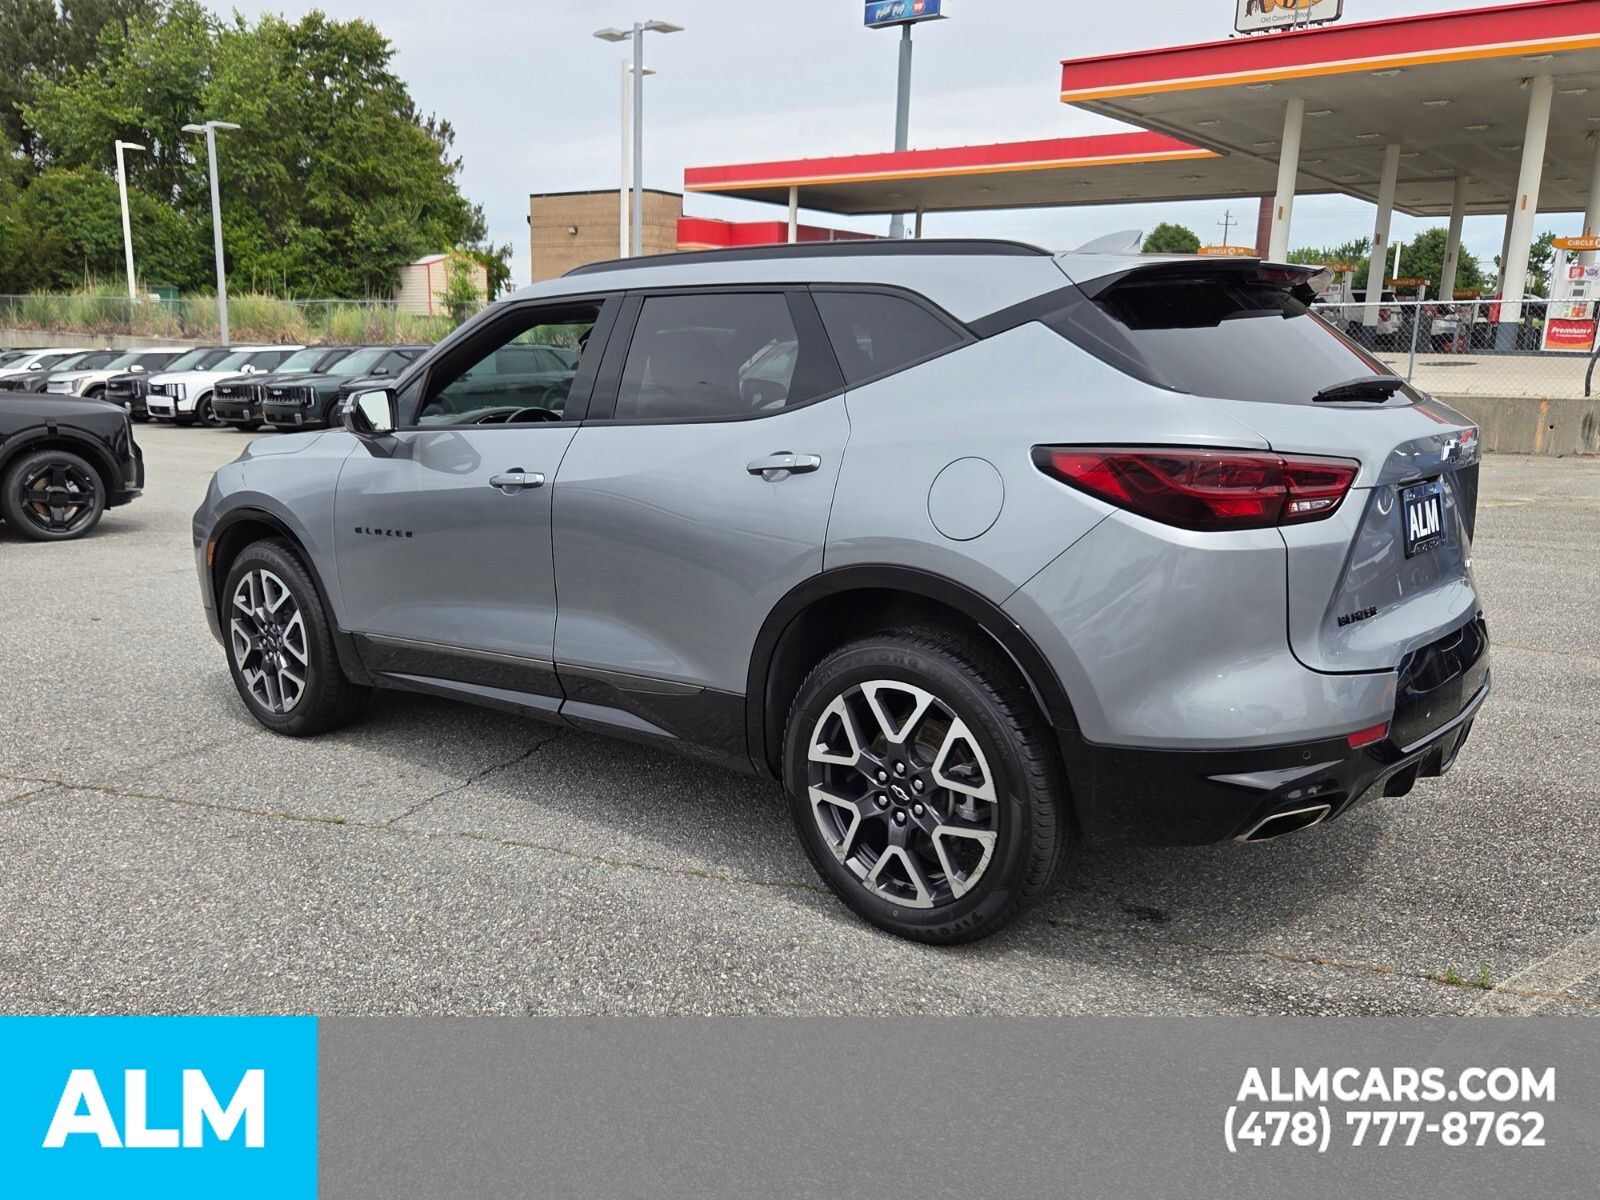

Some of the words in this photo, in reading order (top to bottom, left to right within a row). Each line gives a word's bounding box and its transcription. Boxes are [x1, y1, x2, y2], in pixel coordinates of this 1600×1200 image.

[1260, 16, 1272, 24] Old
[1272, 12, 1295, 22] Country
[1567, 239, 1595, 247] CIRCLE
[1409, 498, 1440, 541] ALM
[354, 526, 413, 538] BLAZER
